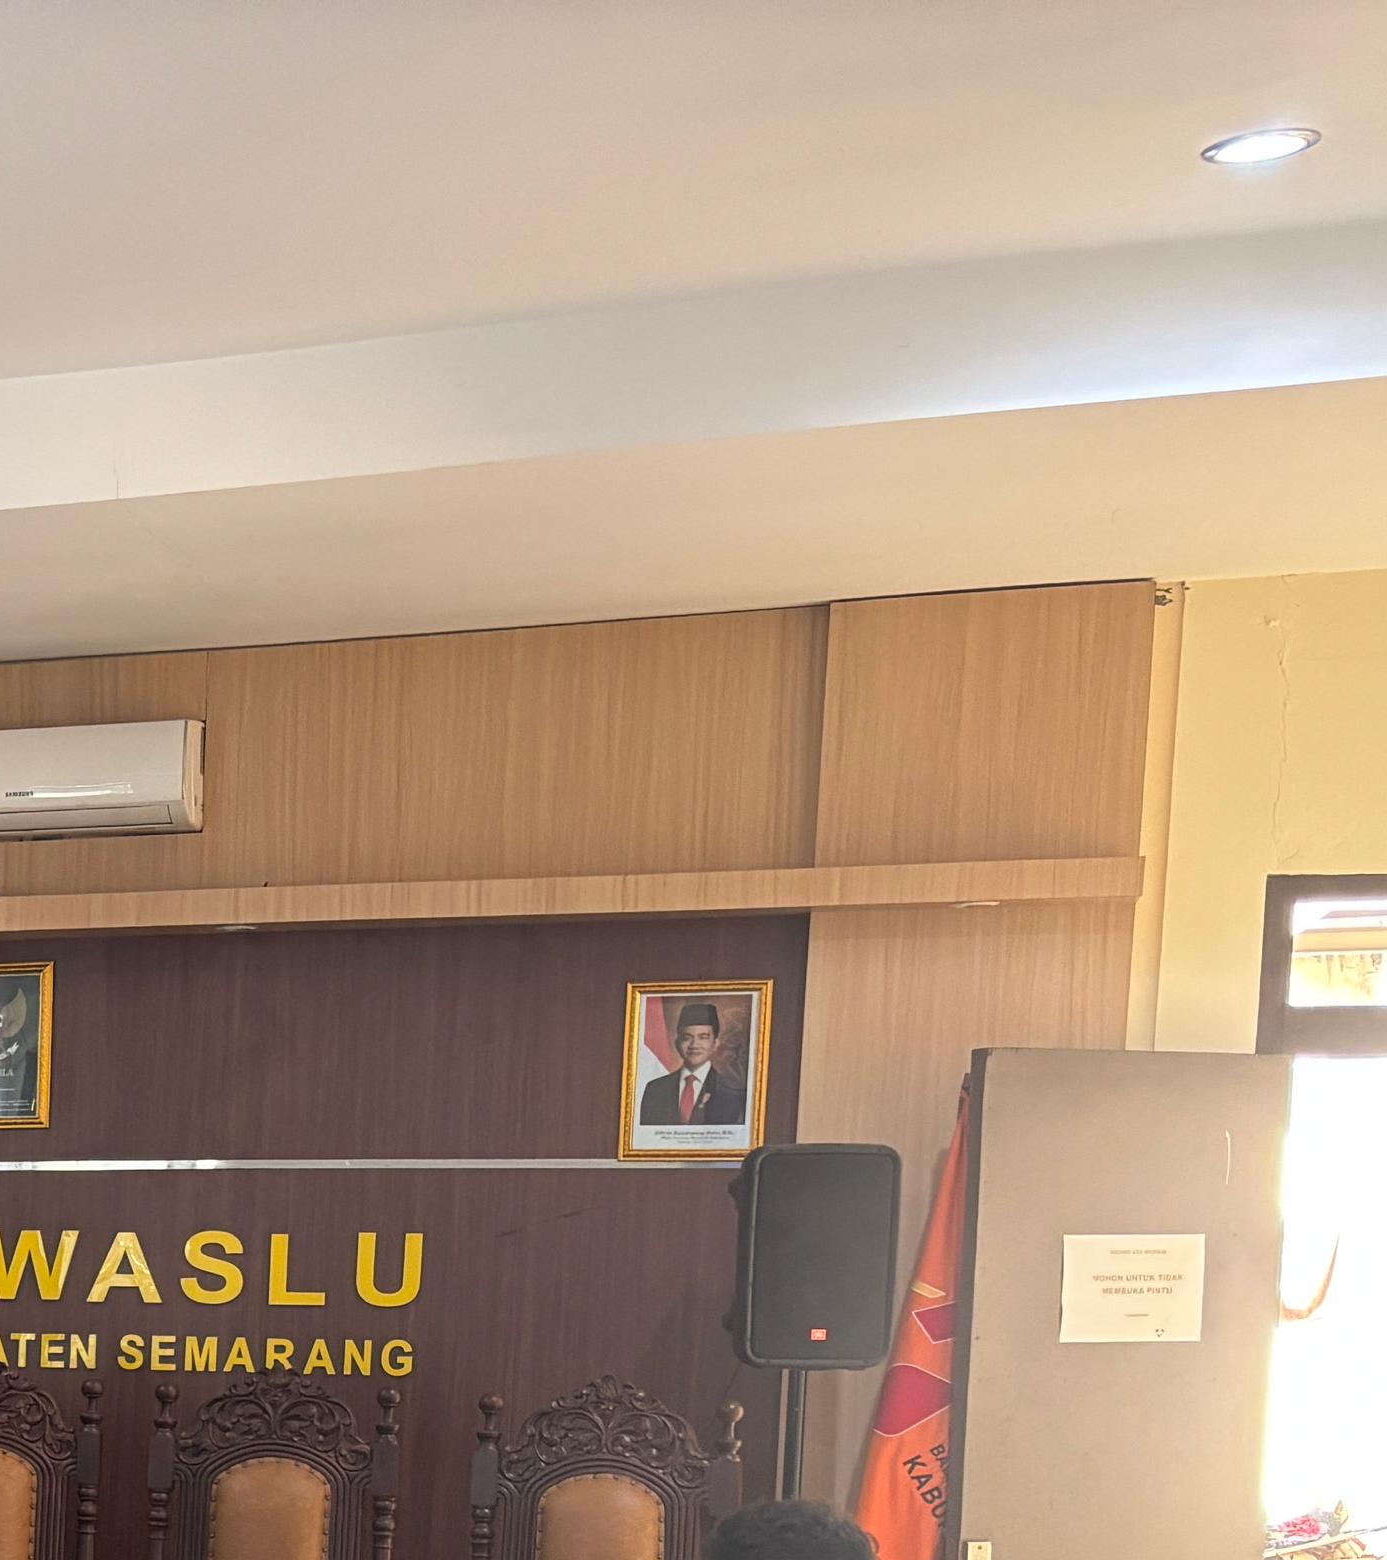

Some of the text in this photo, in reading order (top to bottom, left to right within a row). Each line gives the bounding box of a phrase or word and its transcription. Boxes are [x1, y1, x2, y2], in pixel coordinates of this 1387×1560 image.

[1126, 1274, 1155, 1282] UNTUK
[1147, 1286, 1173, 1294] PINTU
[118, 1335, 414, 1377] SEMARANG
[903, 1454, 948, 1528] KABU
